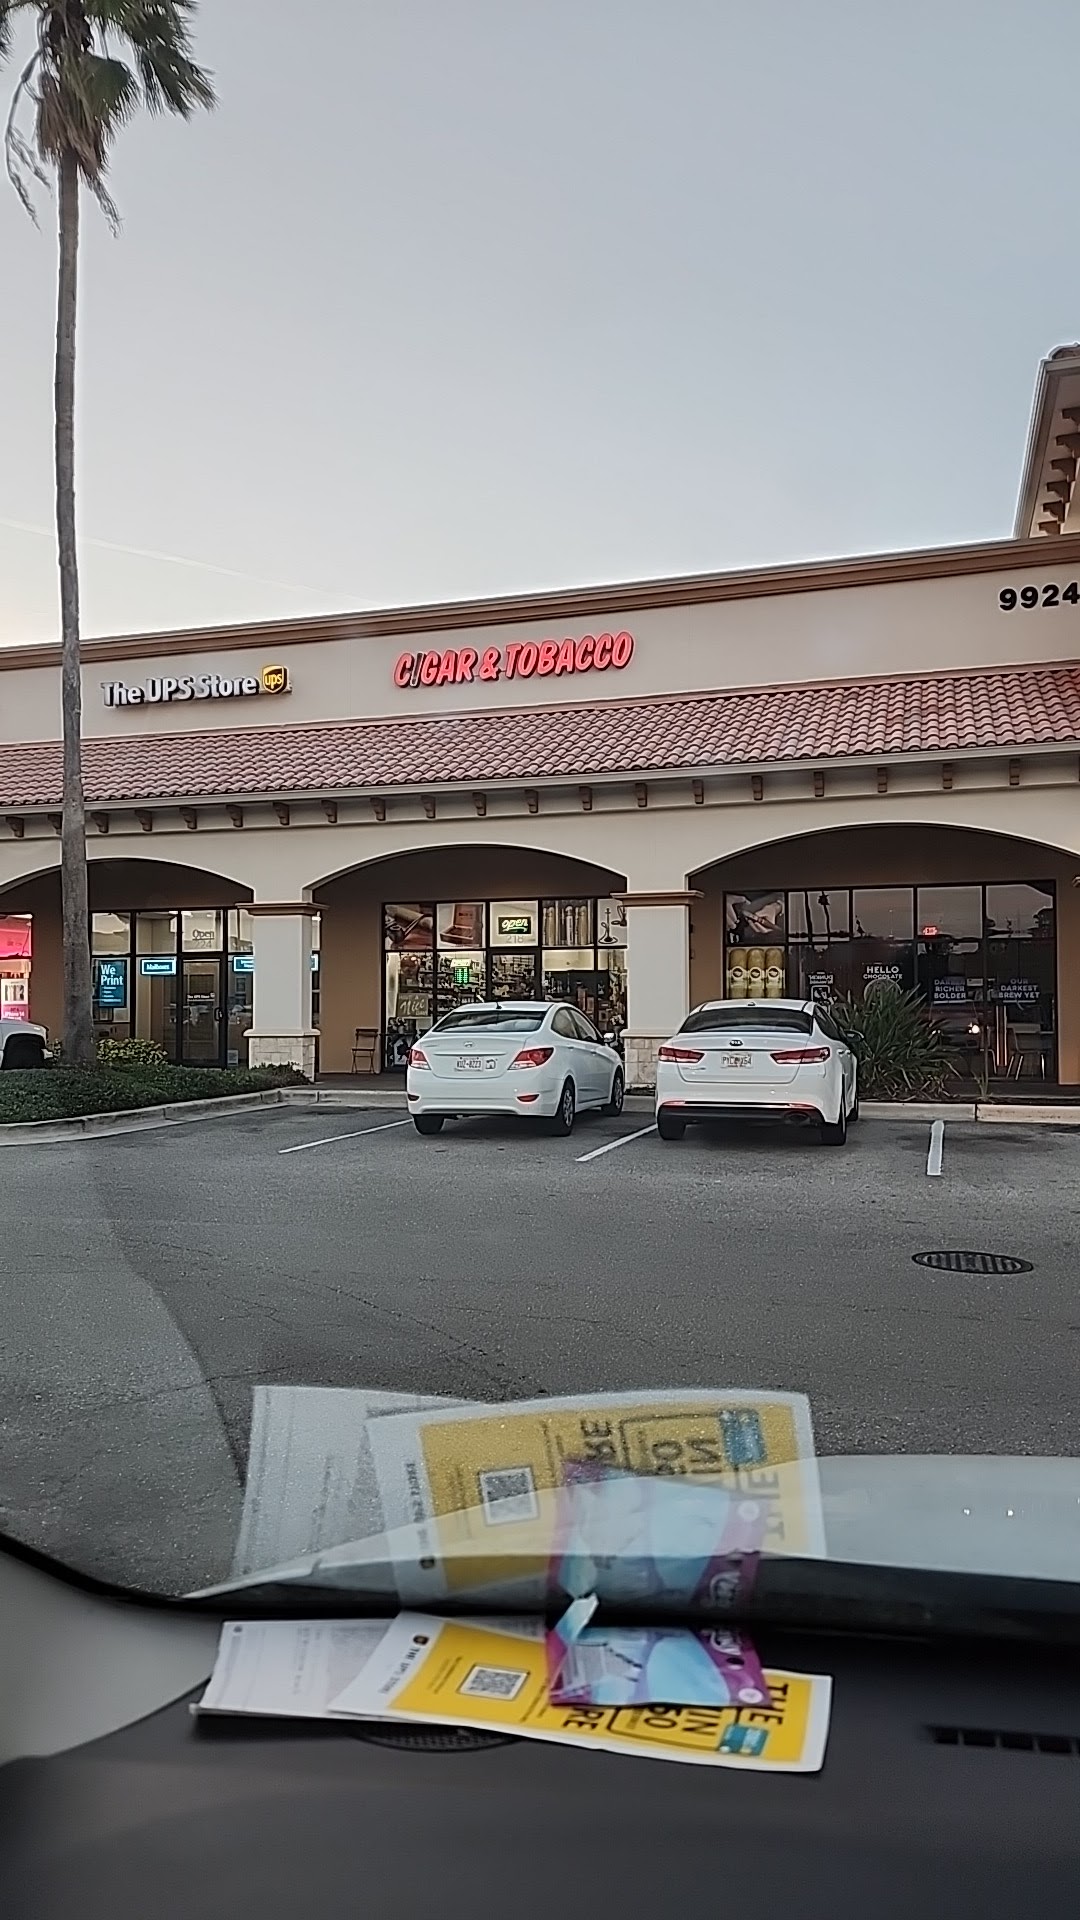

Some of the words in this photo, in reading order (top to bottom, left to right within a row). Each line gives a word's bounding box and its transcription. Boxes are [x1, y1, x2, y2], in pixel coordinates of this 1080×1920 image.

[999, 582, 1080, 611] 9924
[394, 648, 477, 688] CIGAR
[479, 646, 501, 681] &
[504, 631, 635, 679] TOBACCO
[263, 673, 283, 690] ups
[101, 681, 144, 707] The
[146, 677, 193, 703] UPS
[194, 673, 259, 699] Store
[501, 918, 528, 932] open
[192, 929, 215, 940] Open
[100, 964, 116, 975] We
[866, 965, 900, 974] HELLO
[100, 974, 124, 986] Print
[998, 991, 1022, 999] BREW
[1023, 991, 1041, 999] YET
